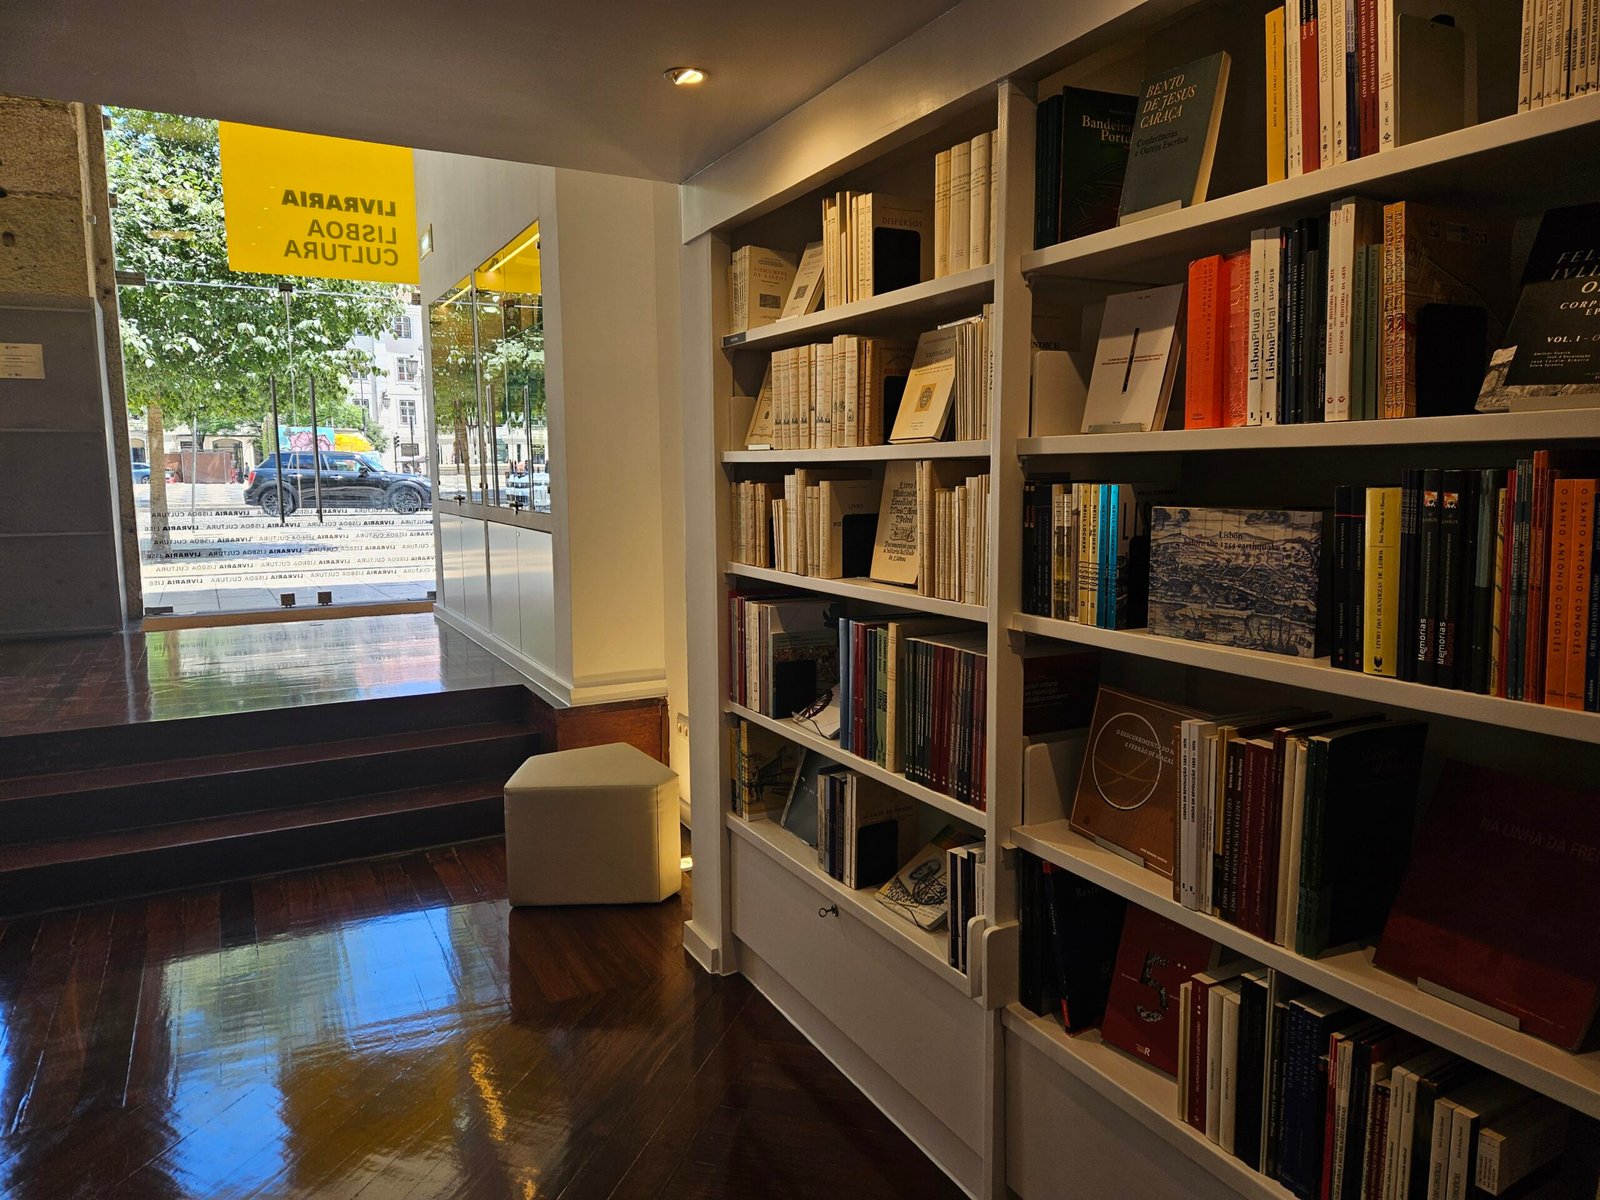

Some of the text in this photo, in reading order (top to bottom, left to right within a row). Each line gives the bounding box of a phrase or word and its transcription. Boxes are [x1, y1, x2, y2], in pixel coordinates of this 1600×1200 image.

[1320, 22, 1327, 33] do
[1334, 16, 1342, 28] do
[1320, 34, 1328, 82] Caminhos
[1334, 30, 1343, 78] Caminhos
[1535, 50, 1543, 70] LISBOA
[1145, 74, 1185, 98] BENTO
[1142, 84, 1197, 114] DE JESUS
[1140, 104, 1183, 129] CARAÇA
[1136, 130, 1178, 148] Conferências
[1140, 146, 1161, 156] Outros
[1162, 136, 1188, 150] Escritos
[882, 216, 922, 228] DISPERSOS
[1556, 248, 1600, 265] FEL
[1032, 341, 1061, 350] NDICE
[1250, 308, 1261, 380] LisboaPlural
[1265, 307, 1276, 380] LisboaPlural
[1546, 336, 1572, 344] VOL.
[1559, 502, 1568, 536] SANTO
[1579, 502, 1588, 536] SANTO
[1218, 531, 1243, 540] Lisbon
[1220, 542, 1236, 550] 1755
[1079, 560, 1089, 590] LISBOA
[1088, 562, 1098, 592] LISBOA
[1556, 542, 1565, 590] ANTÓNIO
[1576, 544, 1586, 592] ANTÓNIO
[1553, 597, 1562, 652] CONGOLÊS
[1572, 598, 1582, 655] CONGOLÊS
[1569, 842, 1600, 864] FRE
